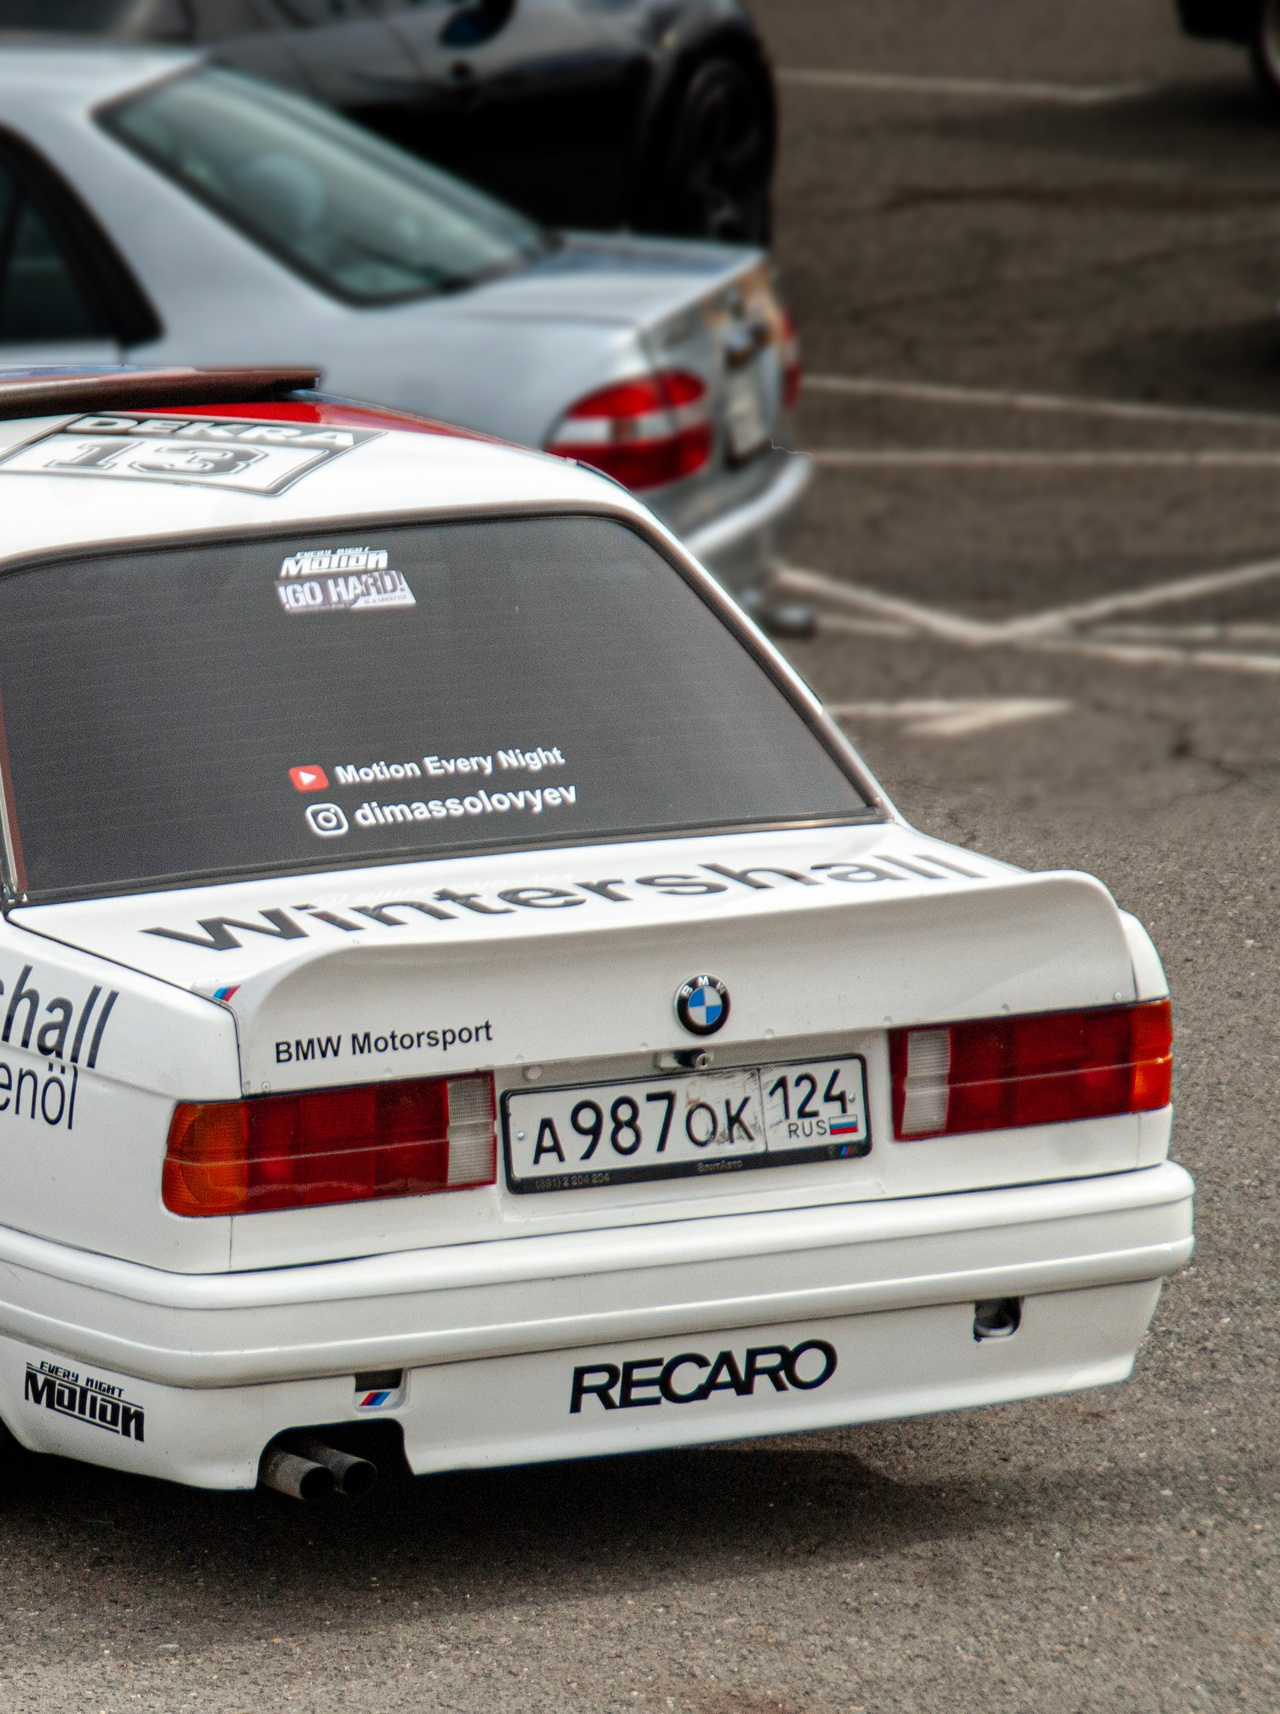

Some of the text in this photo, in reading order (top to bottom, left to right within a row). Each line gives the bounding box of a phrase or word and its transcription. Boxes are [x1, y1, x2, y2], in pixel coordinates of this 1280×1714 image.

[65, 416, 354, 446] DEKRA
[44, 440, 269, 475] 13
[328, 570, 406, 602] HARD!
[334, 746, 566, 785] Motion Every Night
[354, 785, 577, 826] dimassolovyev
[138, 853, 989, 951] Wintershall
[275, 1019, 493, 1063] BMW Motorsport
[768, 1068, 848, 1120] 124
[788, 1117, 828, 1139] RUS
[40, 1360, 125, 1398] EVERY NIGHT
[569, 1339, 838, 1414] RECARO
